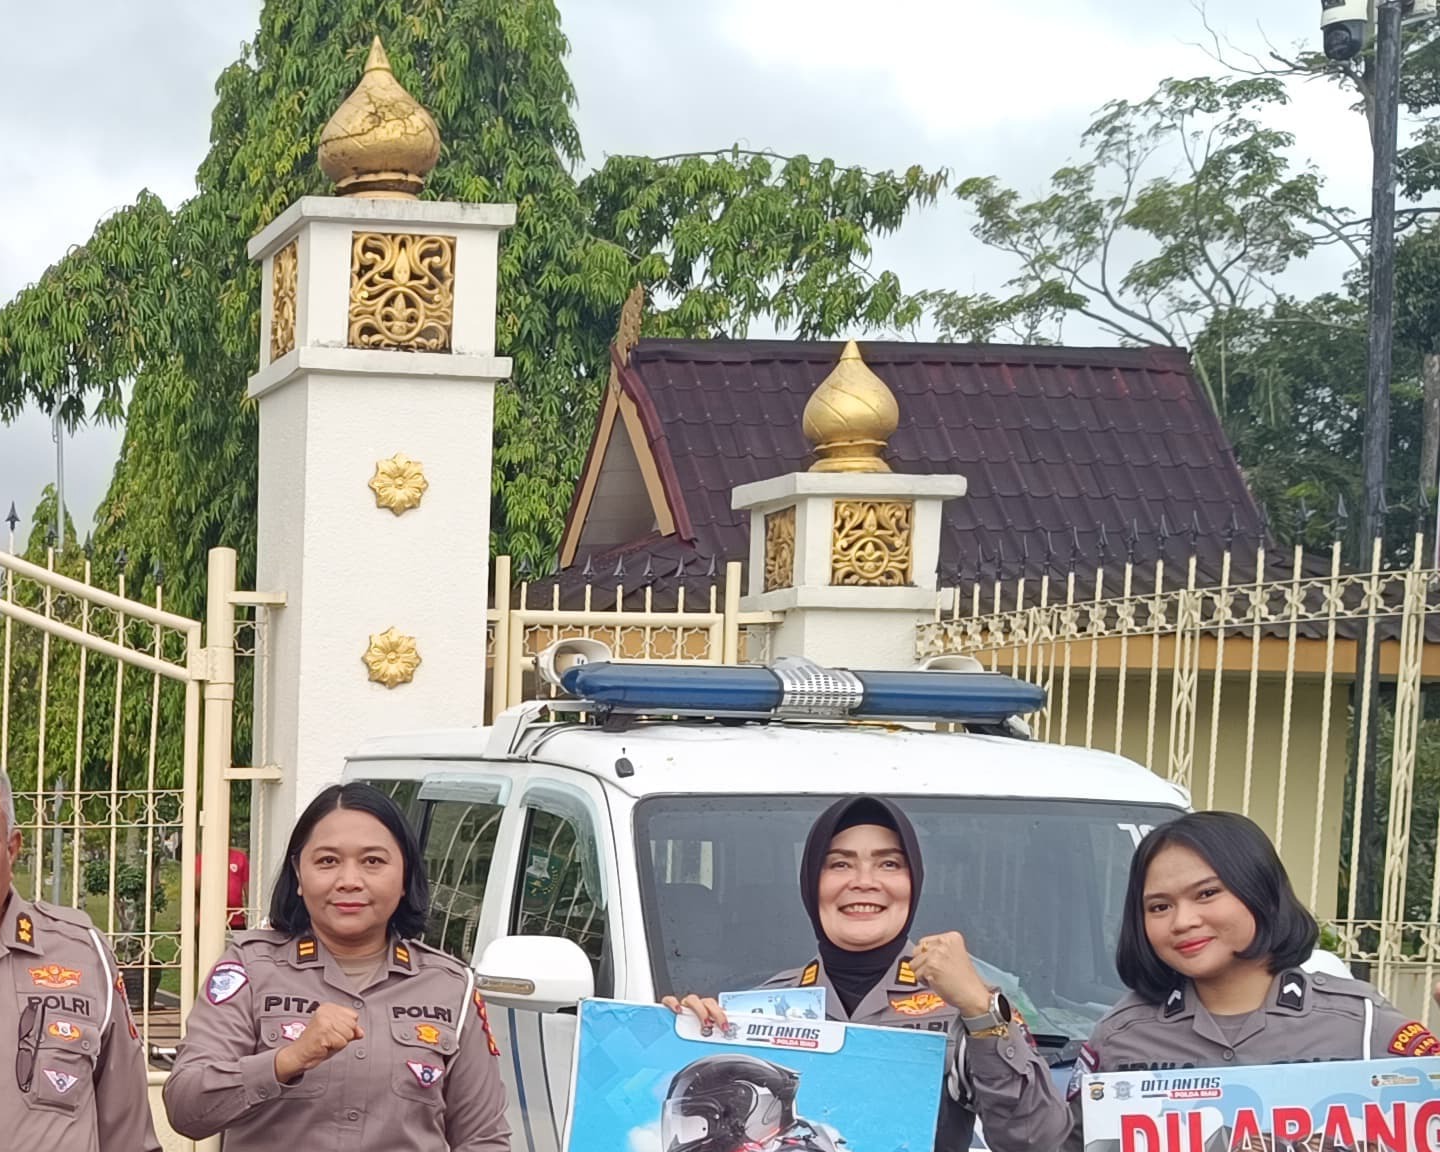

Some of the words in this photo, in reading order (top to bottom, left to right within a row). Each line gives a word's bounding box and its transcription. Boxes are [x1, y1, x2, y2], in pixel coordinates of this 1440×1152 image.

[27, 995, 90, 1016] POLRI
[264, 995, 321, 1014] PITA
[393, 1005, 453, 1023] POLRI
[746, 1022, 821, 1040] DITLANTAS
[1393, 1023, 1425, 1051] POLDA
[1141, 1076, 1221, 1091] DITLANTAS
